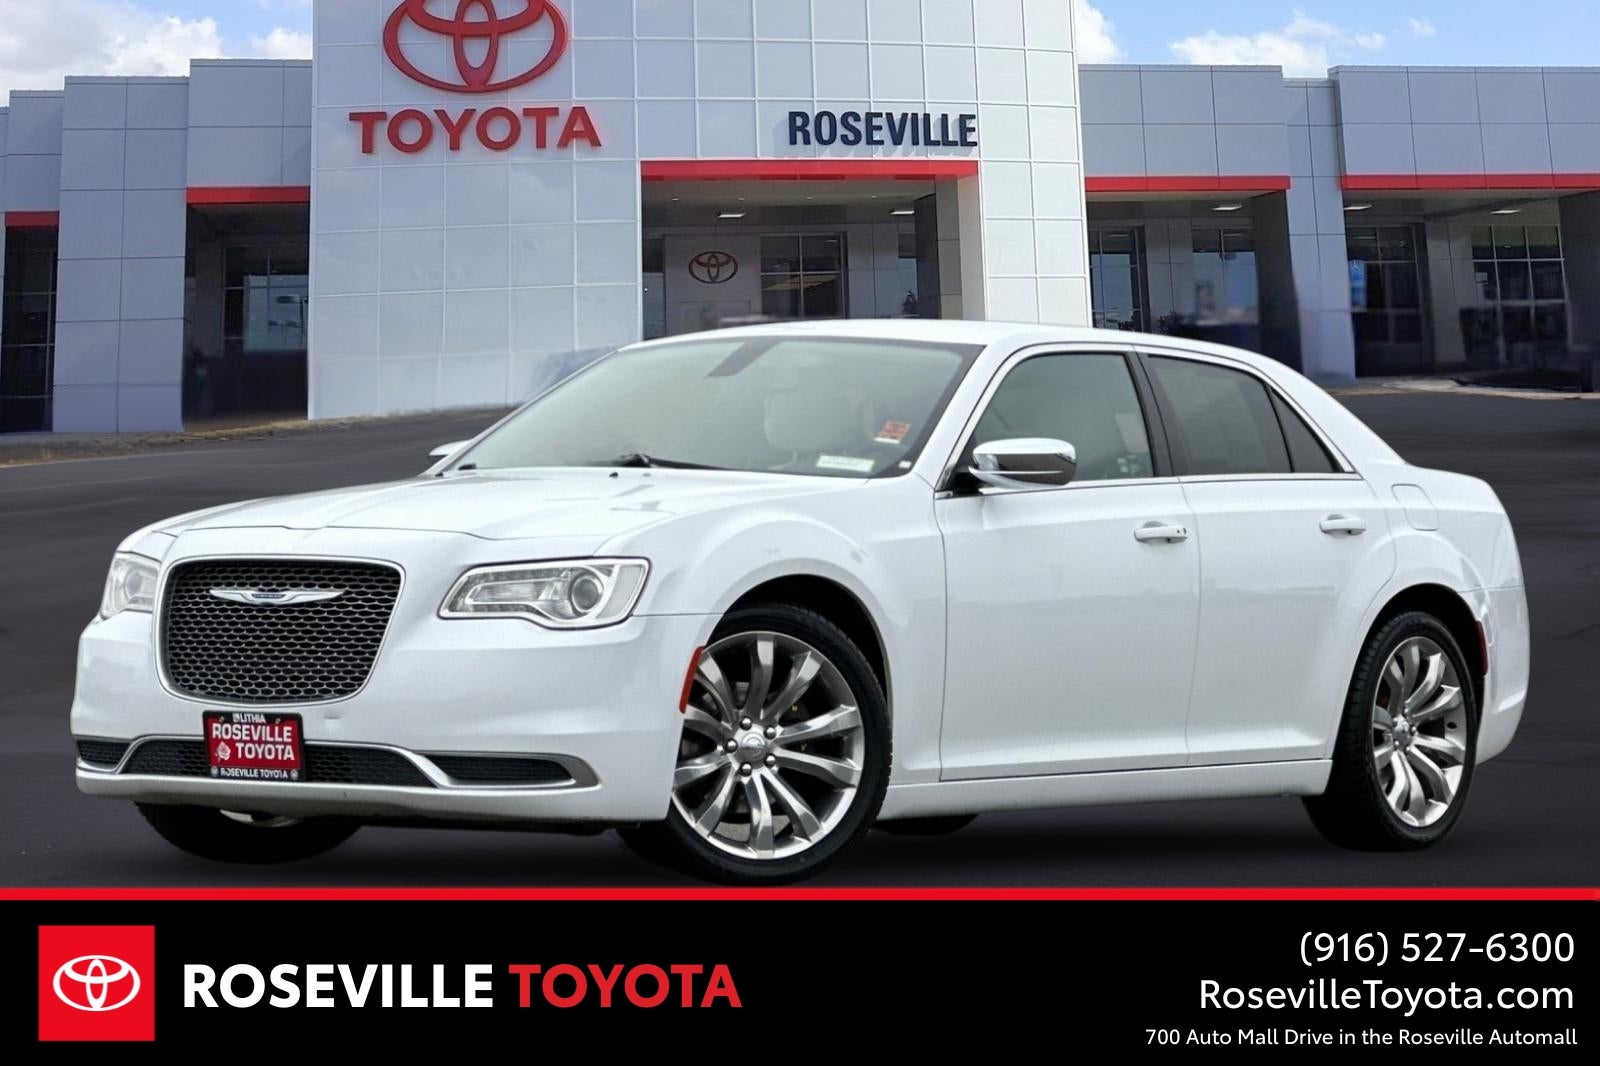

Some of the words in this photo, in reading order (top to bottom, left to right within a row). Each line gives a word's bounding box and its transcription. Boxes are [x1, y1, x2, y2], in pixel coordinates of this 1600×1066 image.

[349, 106, 602, 154] TOYOTA
[788, 110, 978, 147] ROSEVILLE
[239, 713, 266, 723] LITHIA
[212, 723, 292, 742] ROSEVILLE
[235, 742, 295, 760] TOYOTA
[220, 767, 259, 778] ROSEVILLE
[260, 769, 288, 779] TOYOTA
